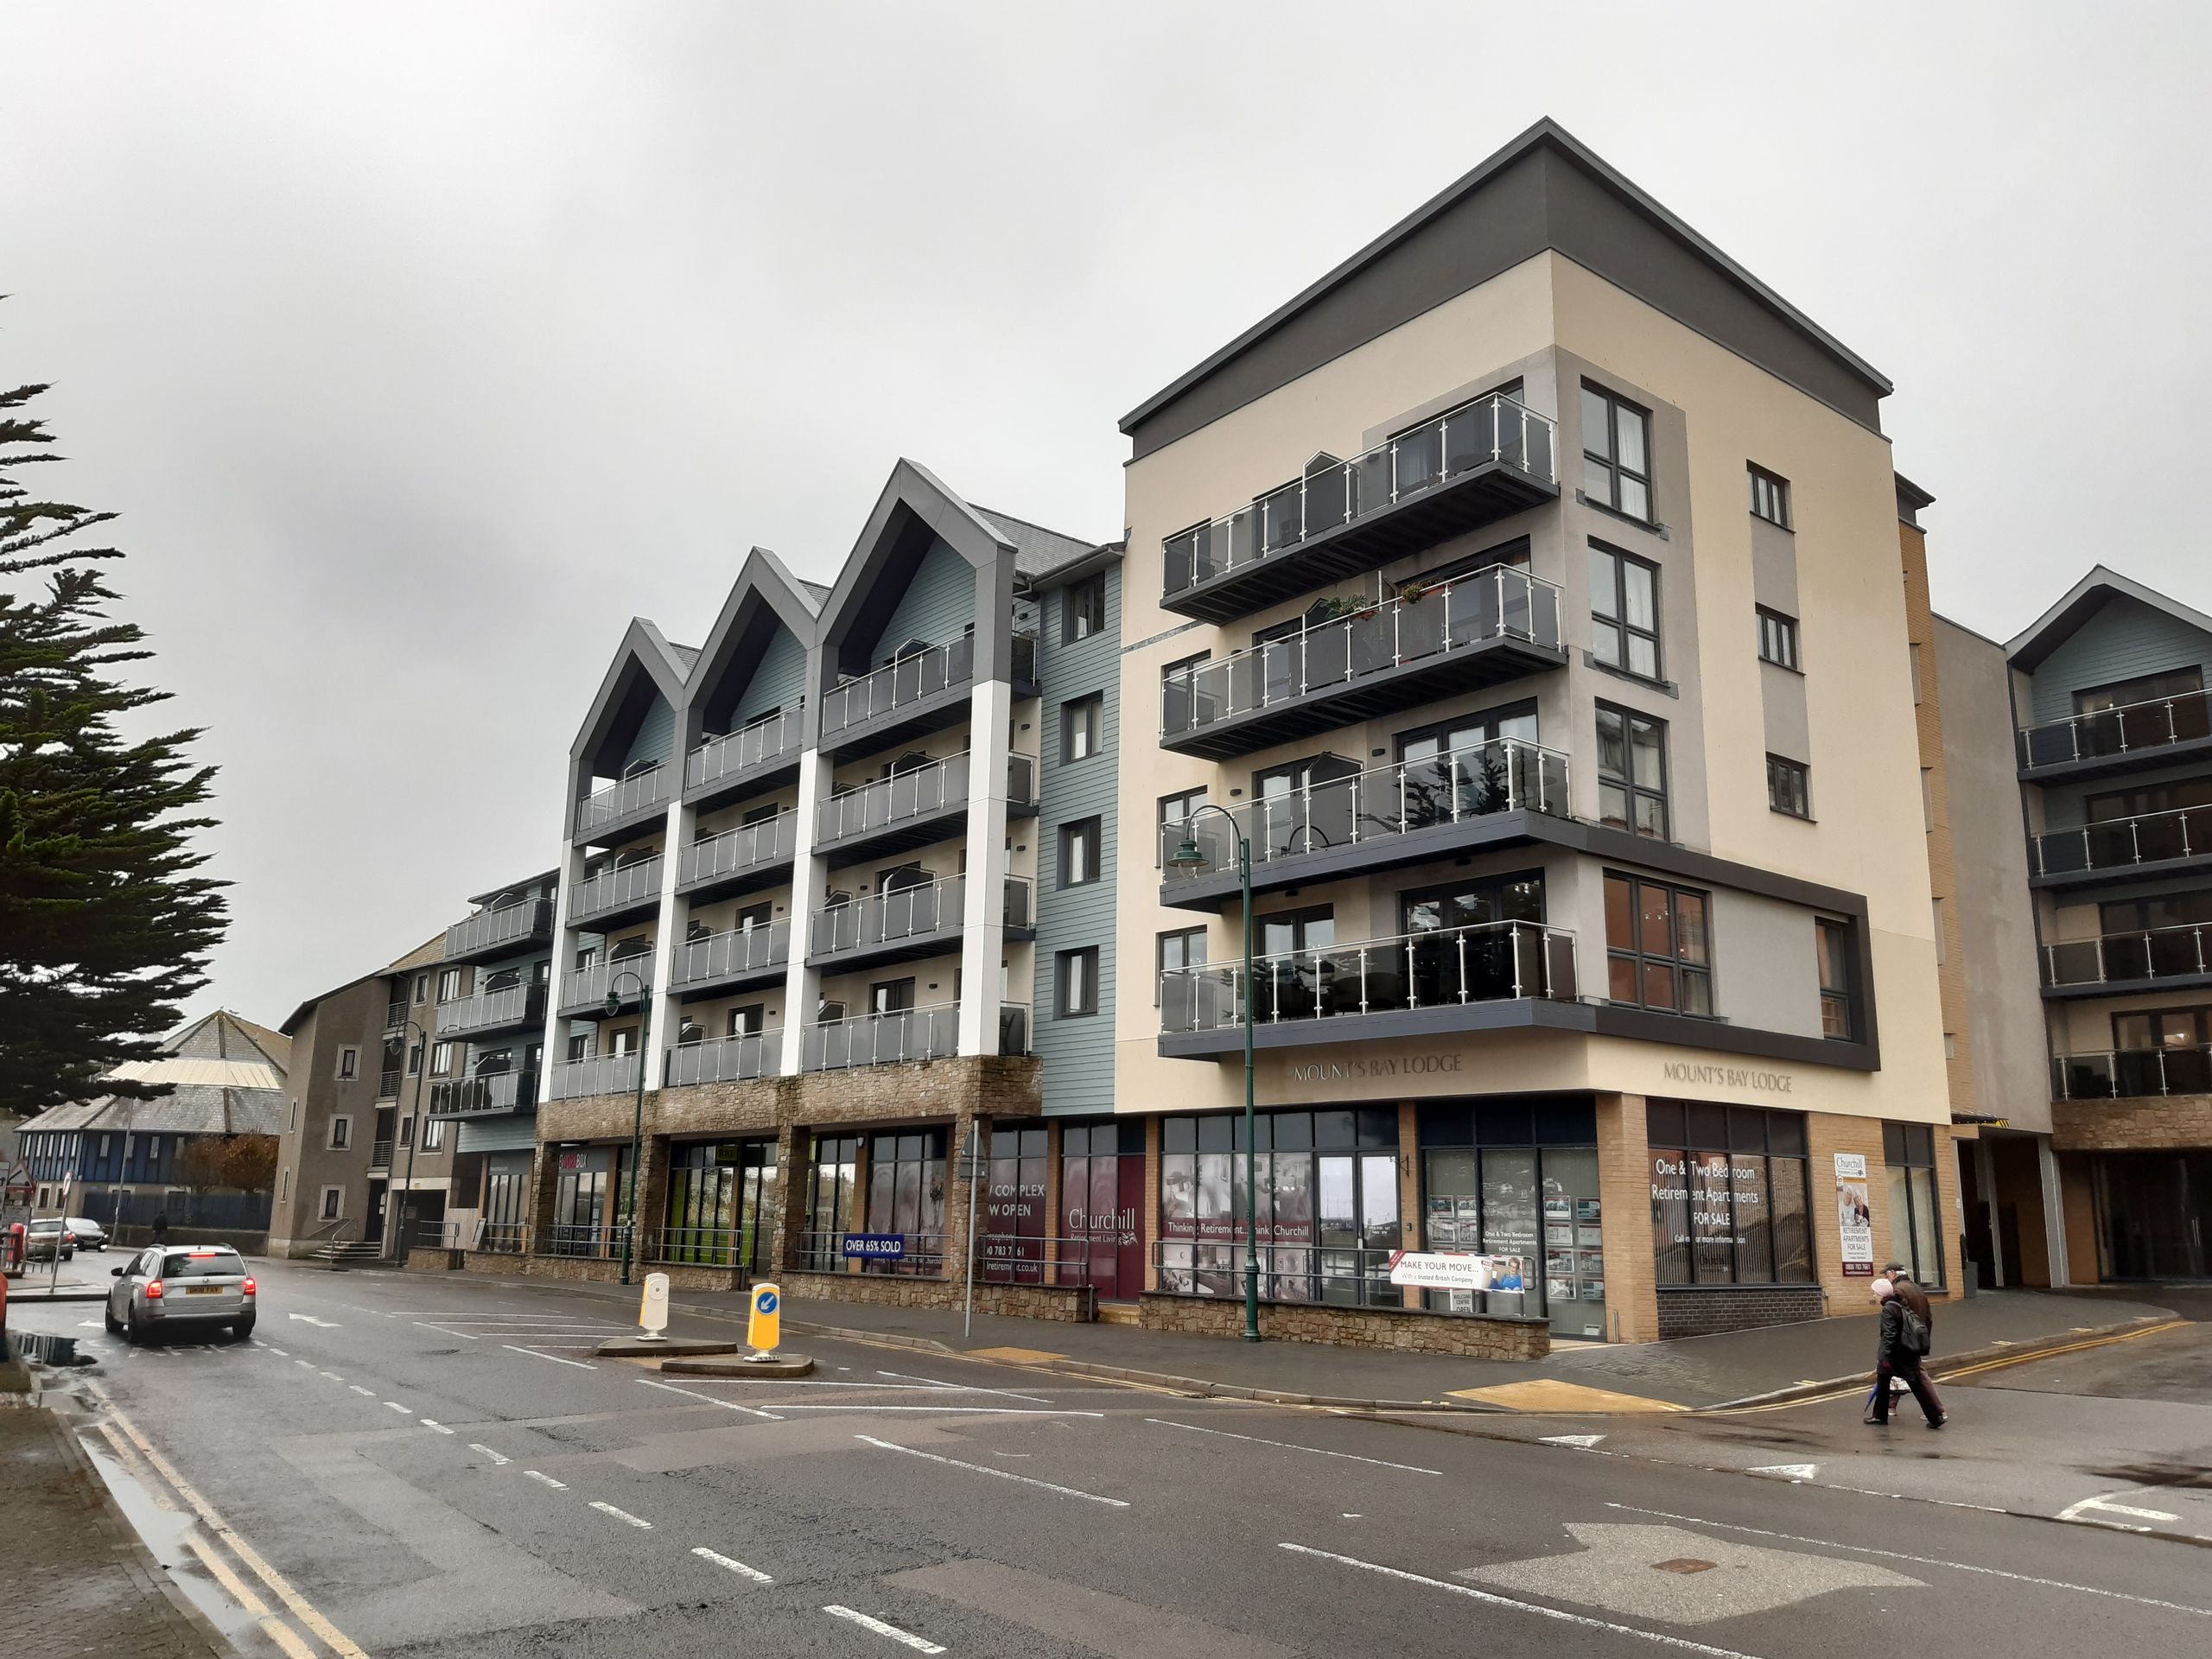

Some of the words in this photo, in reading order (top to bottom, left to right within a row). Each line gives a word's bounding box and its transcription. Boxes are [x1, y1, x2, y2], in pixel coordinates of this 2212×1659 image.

[1294, 1061, 1365, 1081] MOUNT'S
[1370, 1057, 1397, 1077] BAY
[1403, 1053, 1463, 1074] LODGE
[1664, 1062, 1724, 1085] MOUNT'S
[1726, 1069, 1749, 1087] BAY
[1751, 1071, 1792, 1092] LODGE
[1836, 1156, 1863, 1168] Churchill
[1656, 1159, 1677, 1174] One
[1679, 1160, 1687, 1175] &
[1690, 1161, 1711, 1177] Two
[1712, 1162, 1755, 1179] Bedroom
[1652, 1184, 1705, 1201] Retirement
[1706, 1186, 1758, 1206] Apartments
[1001, 1203, 1031, 1216] OPEN
[1069, 1207, 1135, 1230] Churchill
[1694, 1212, 1710, 1224] FOR
[1711, 1213, 1731, 1225] SALE
[1255, 1224, 1270, 1235] ink
[1274, 1224, 1309, 1236] Churchill
[845, 1239, 865, 1251] OVER
[866, 1240, 880, 1251] 65%
[880, 1241, 901, 1253] SOLD
[995, 1246, 1007, 1256] 783
[1008, 1246, 1025, 1256] 761
[1400, 1260, 1422, 1269] MAKE
[1424, 1261, 1446, 1271] YOUR
